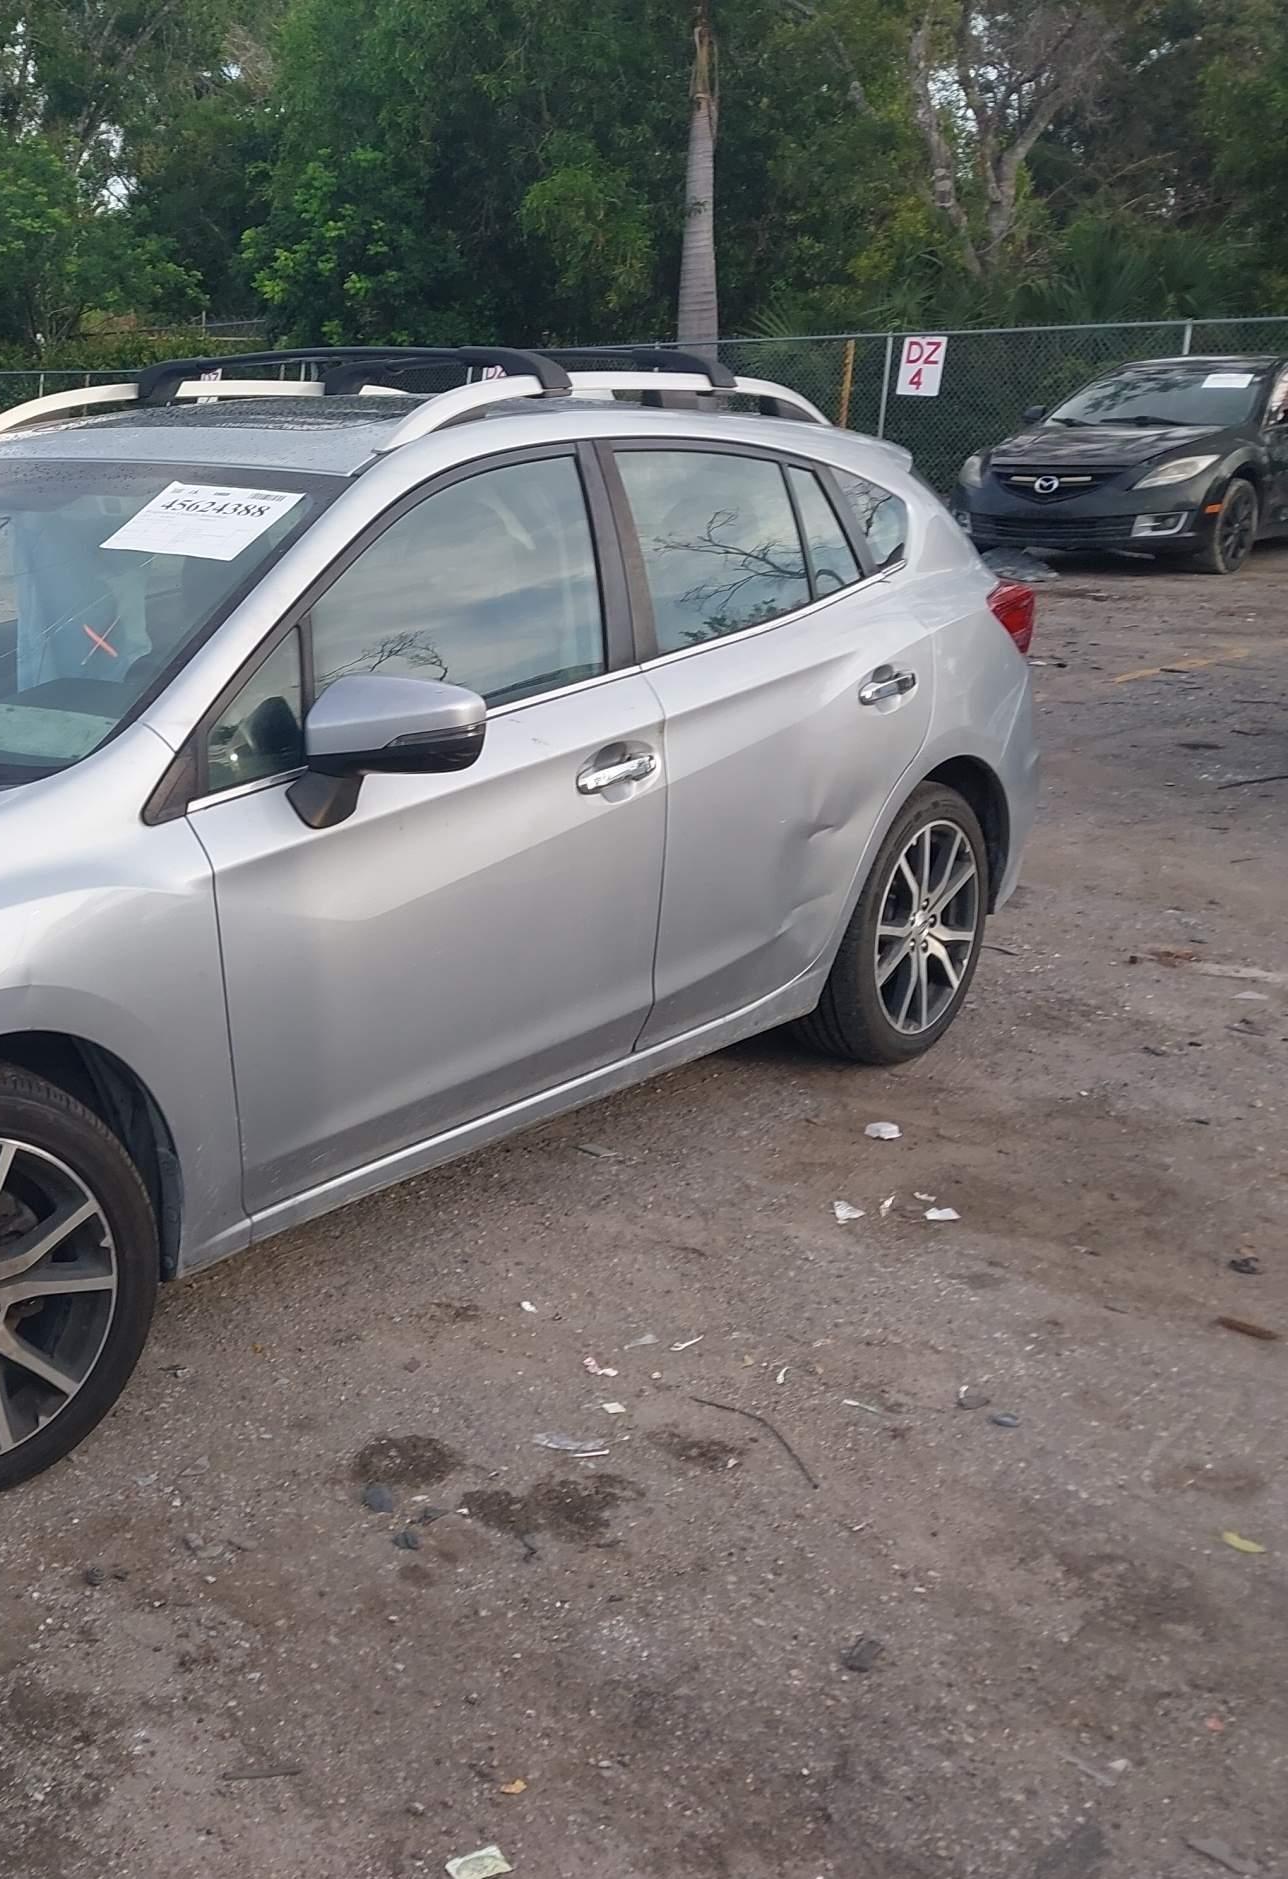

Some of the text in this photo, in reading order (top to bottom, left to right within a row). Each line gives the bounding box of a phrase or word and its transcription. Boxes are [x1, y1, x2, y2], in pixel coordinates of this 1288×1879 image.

[905, 341, 943, 365] DZ
[908, 368, 923, 391] 4
[161, 498, 271, 518] 45624388
